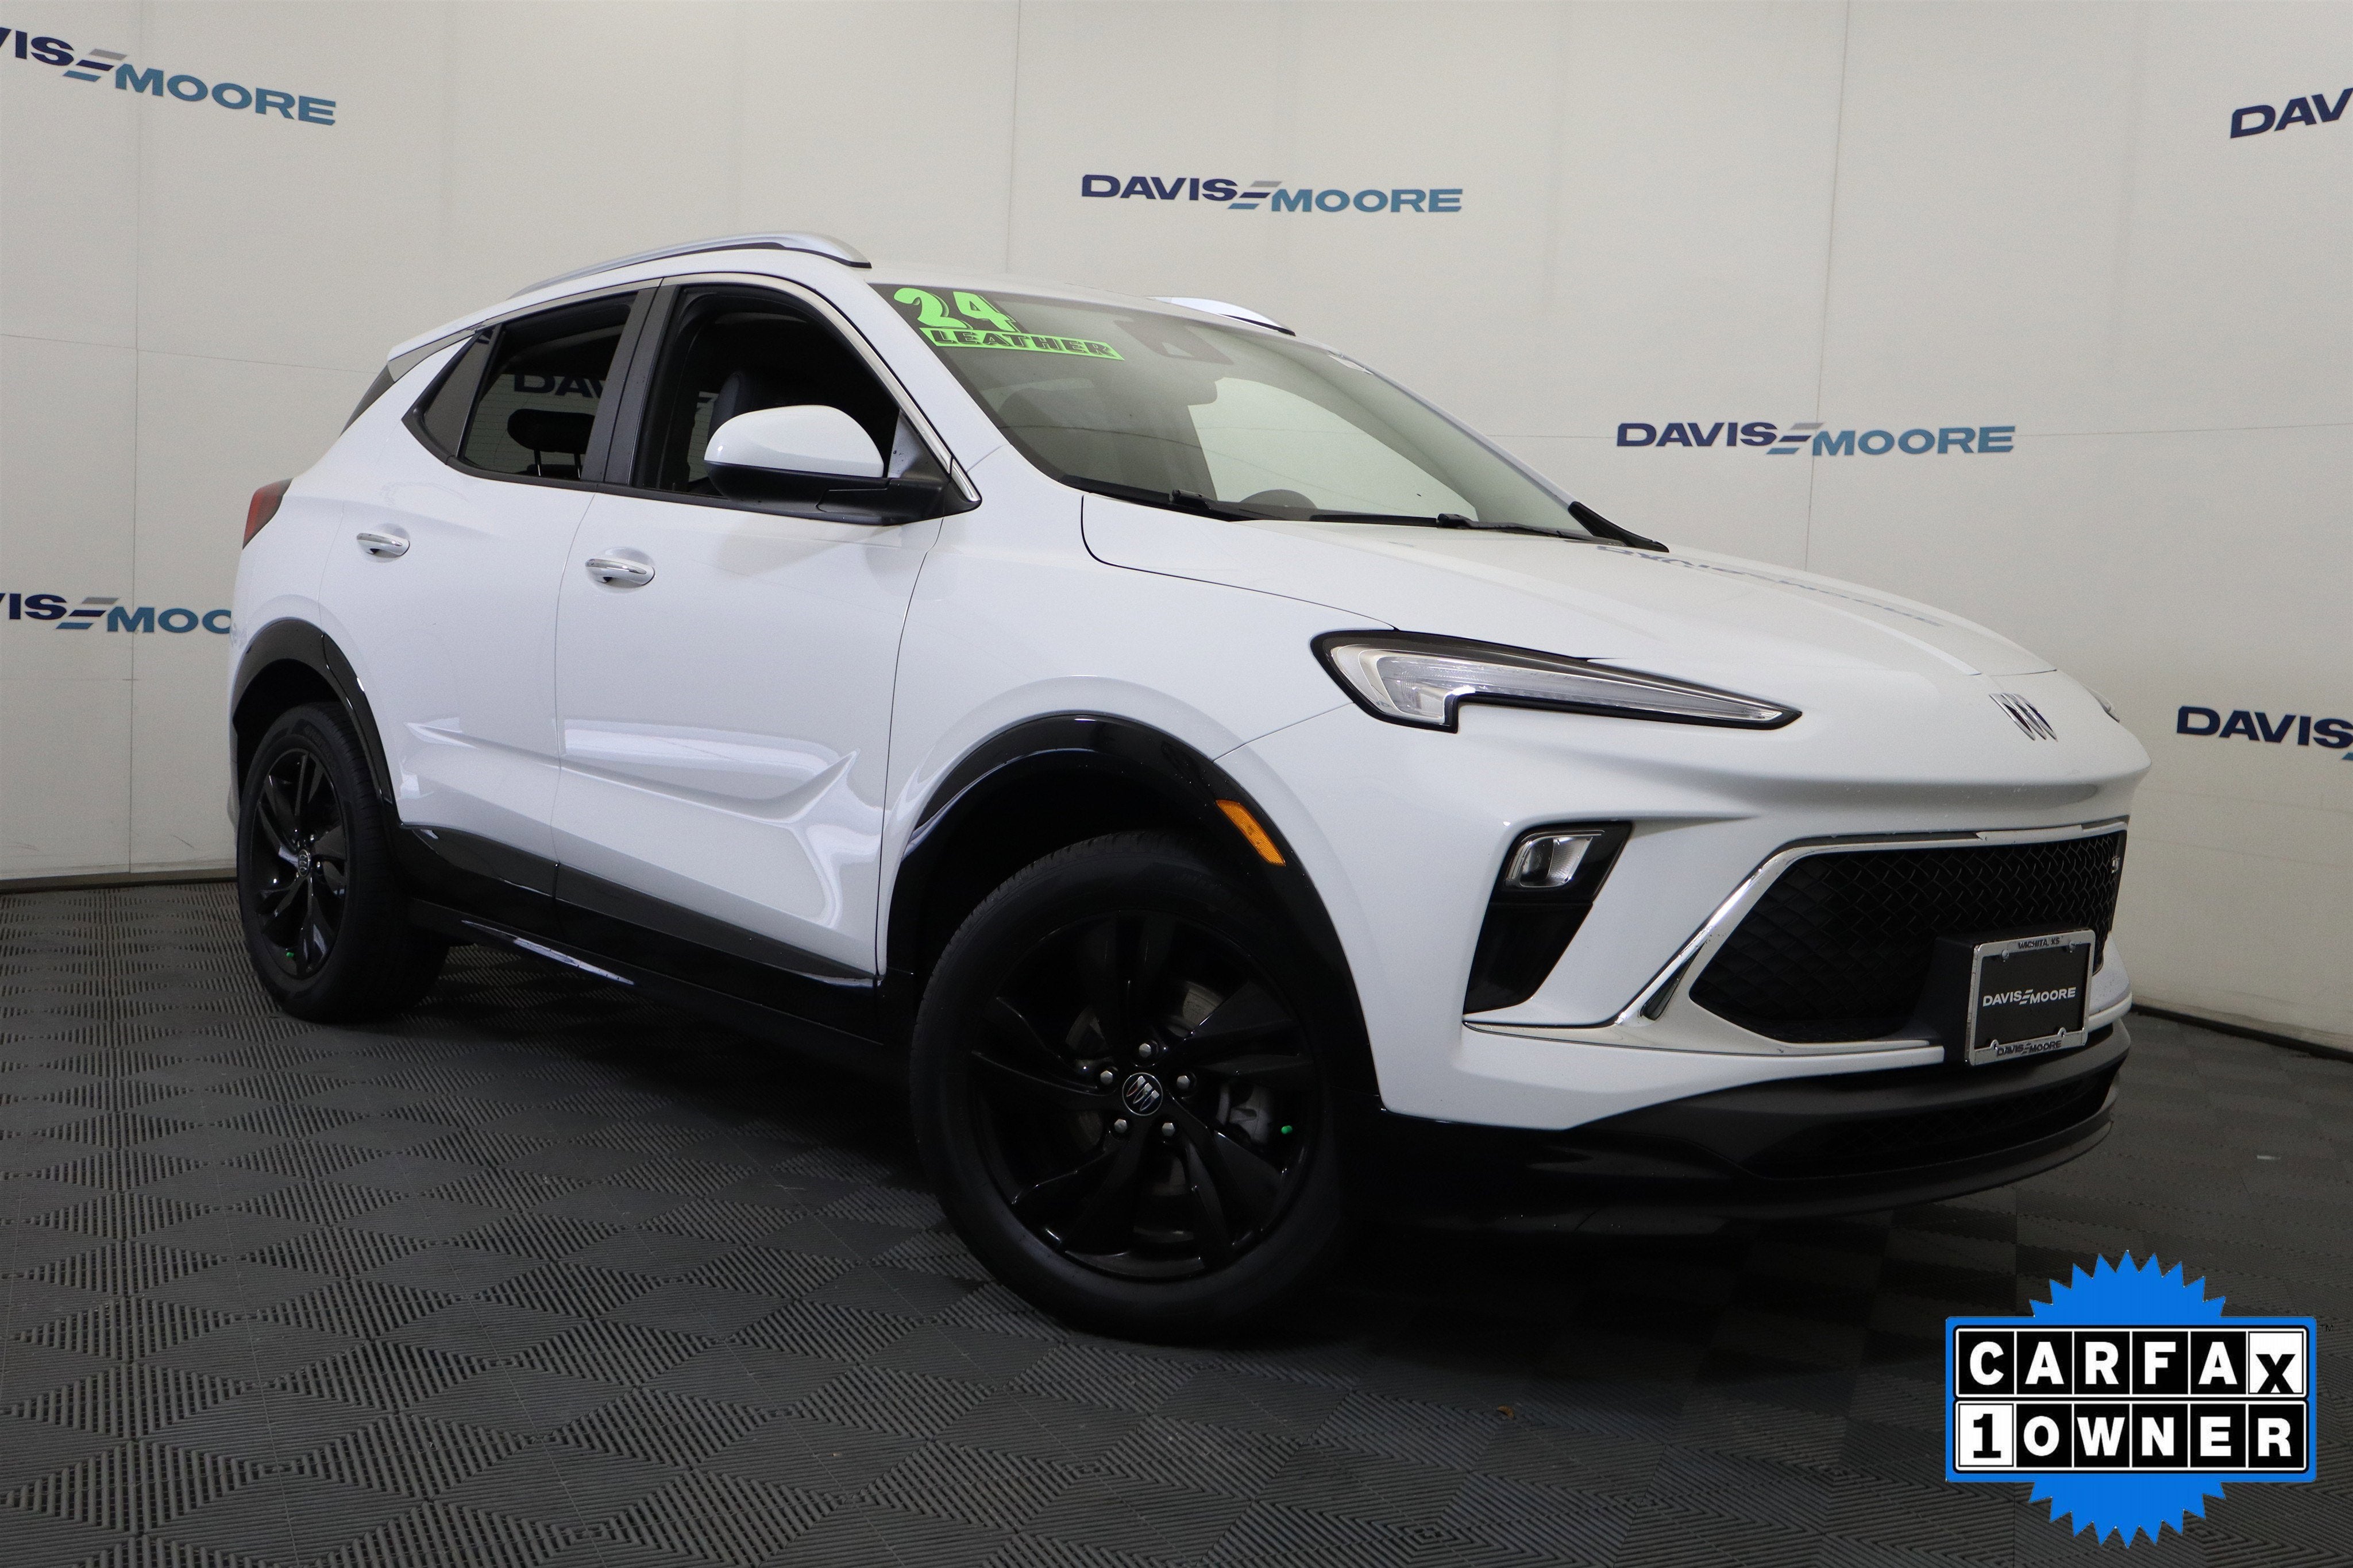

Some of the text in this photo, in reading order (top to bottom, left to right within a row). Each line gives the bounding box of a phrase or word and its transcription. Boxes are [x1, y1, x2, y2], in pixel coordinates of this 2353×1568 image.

[115, 64, 336, 126] MOORE
[1082, 174, 1463, 213] DAVIS MOORE
[894, 287, 1020, 333] 24
[929, 330, 1114, 357] LEATHER
[1617, 422, 2016, 455] DAVIS MOORE
[2177, 706, 2353, 748] DAVIS
[2051, 937, 2060, 945] KS
[1982, 987, 2076, 1007] DAVIS MOORE
[1997, 1040, 2061, 1056] DAVIS MOORE
